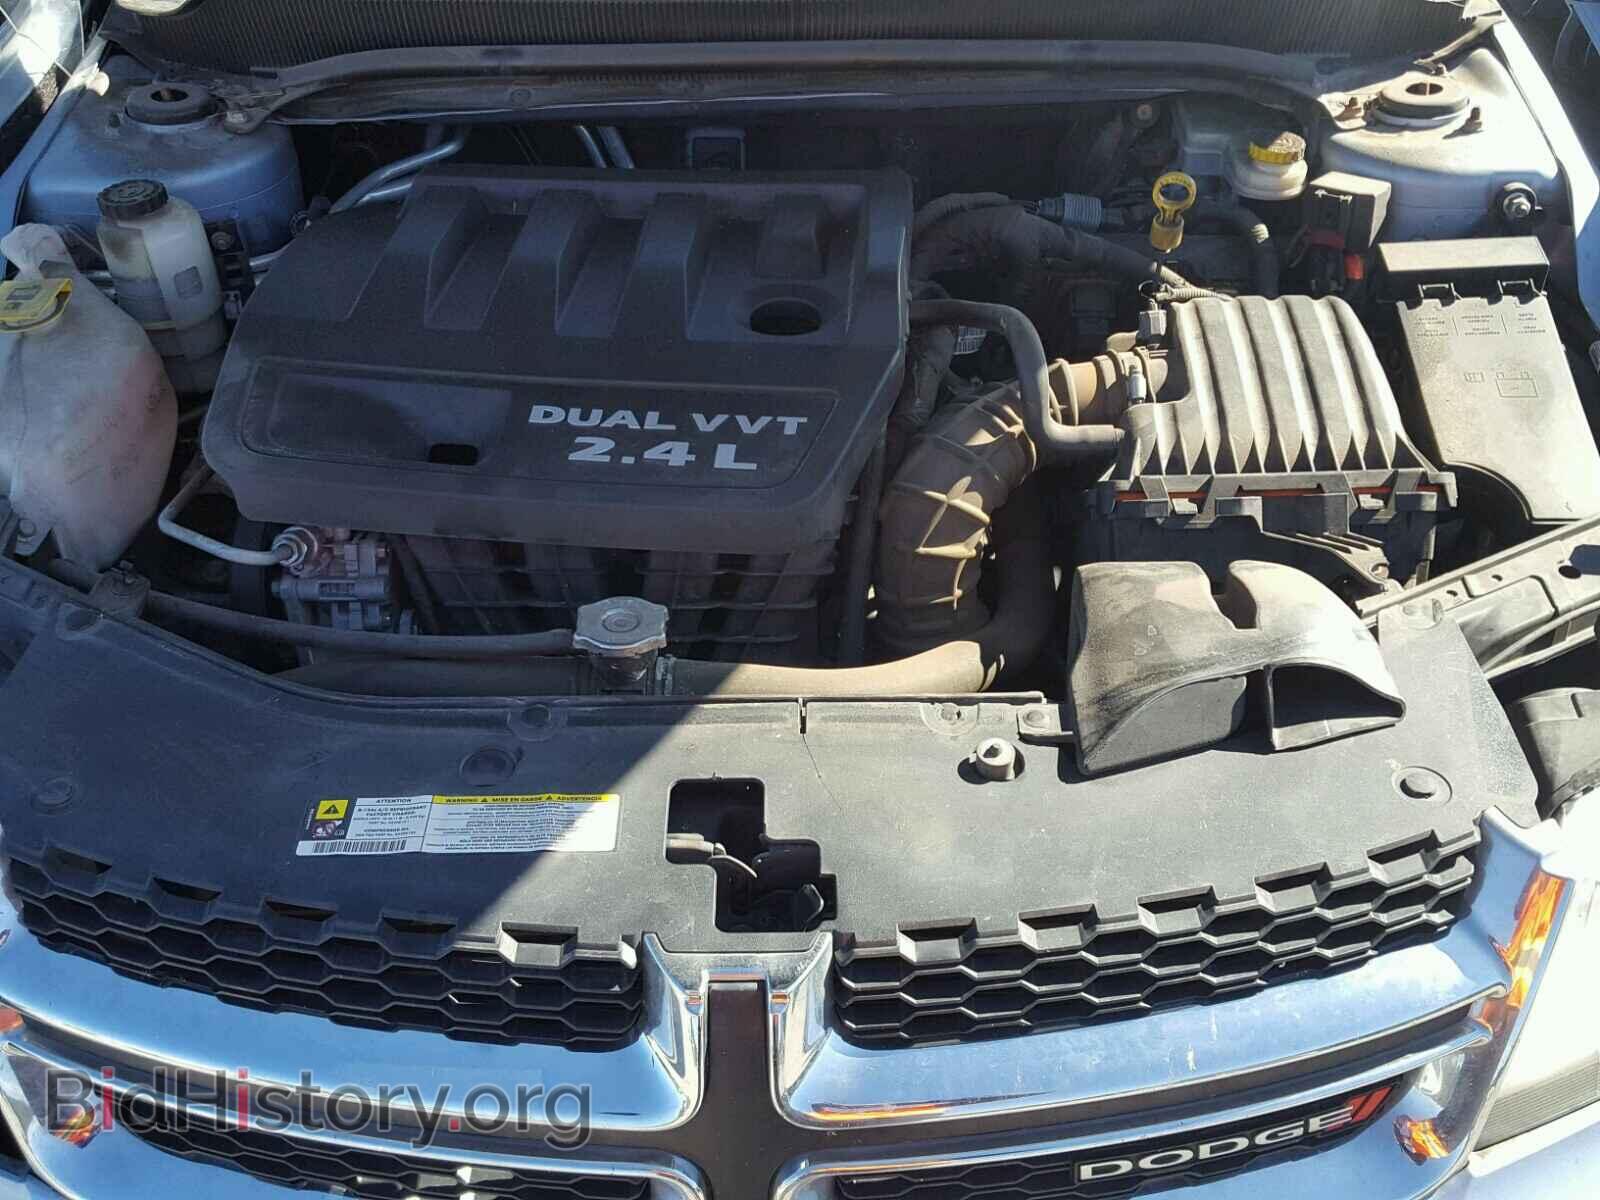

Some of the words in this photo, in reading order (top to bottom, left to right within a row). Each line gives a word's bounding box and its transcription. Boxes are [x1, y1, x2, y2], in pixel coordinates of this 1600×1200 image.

[528, 404, 676, 430] DUAL
[692, 413, 808, 435] VVT
[568, 436, 696, 467] 2.4
[713, 443, 758, 470] L
[1079, 1104, 1354, 1181] DODGE
